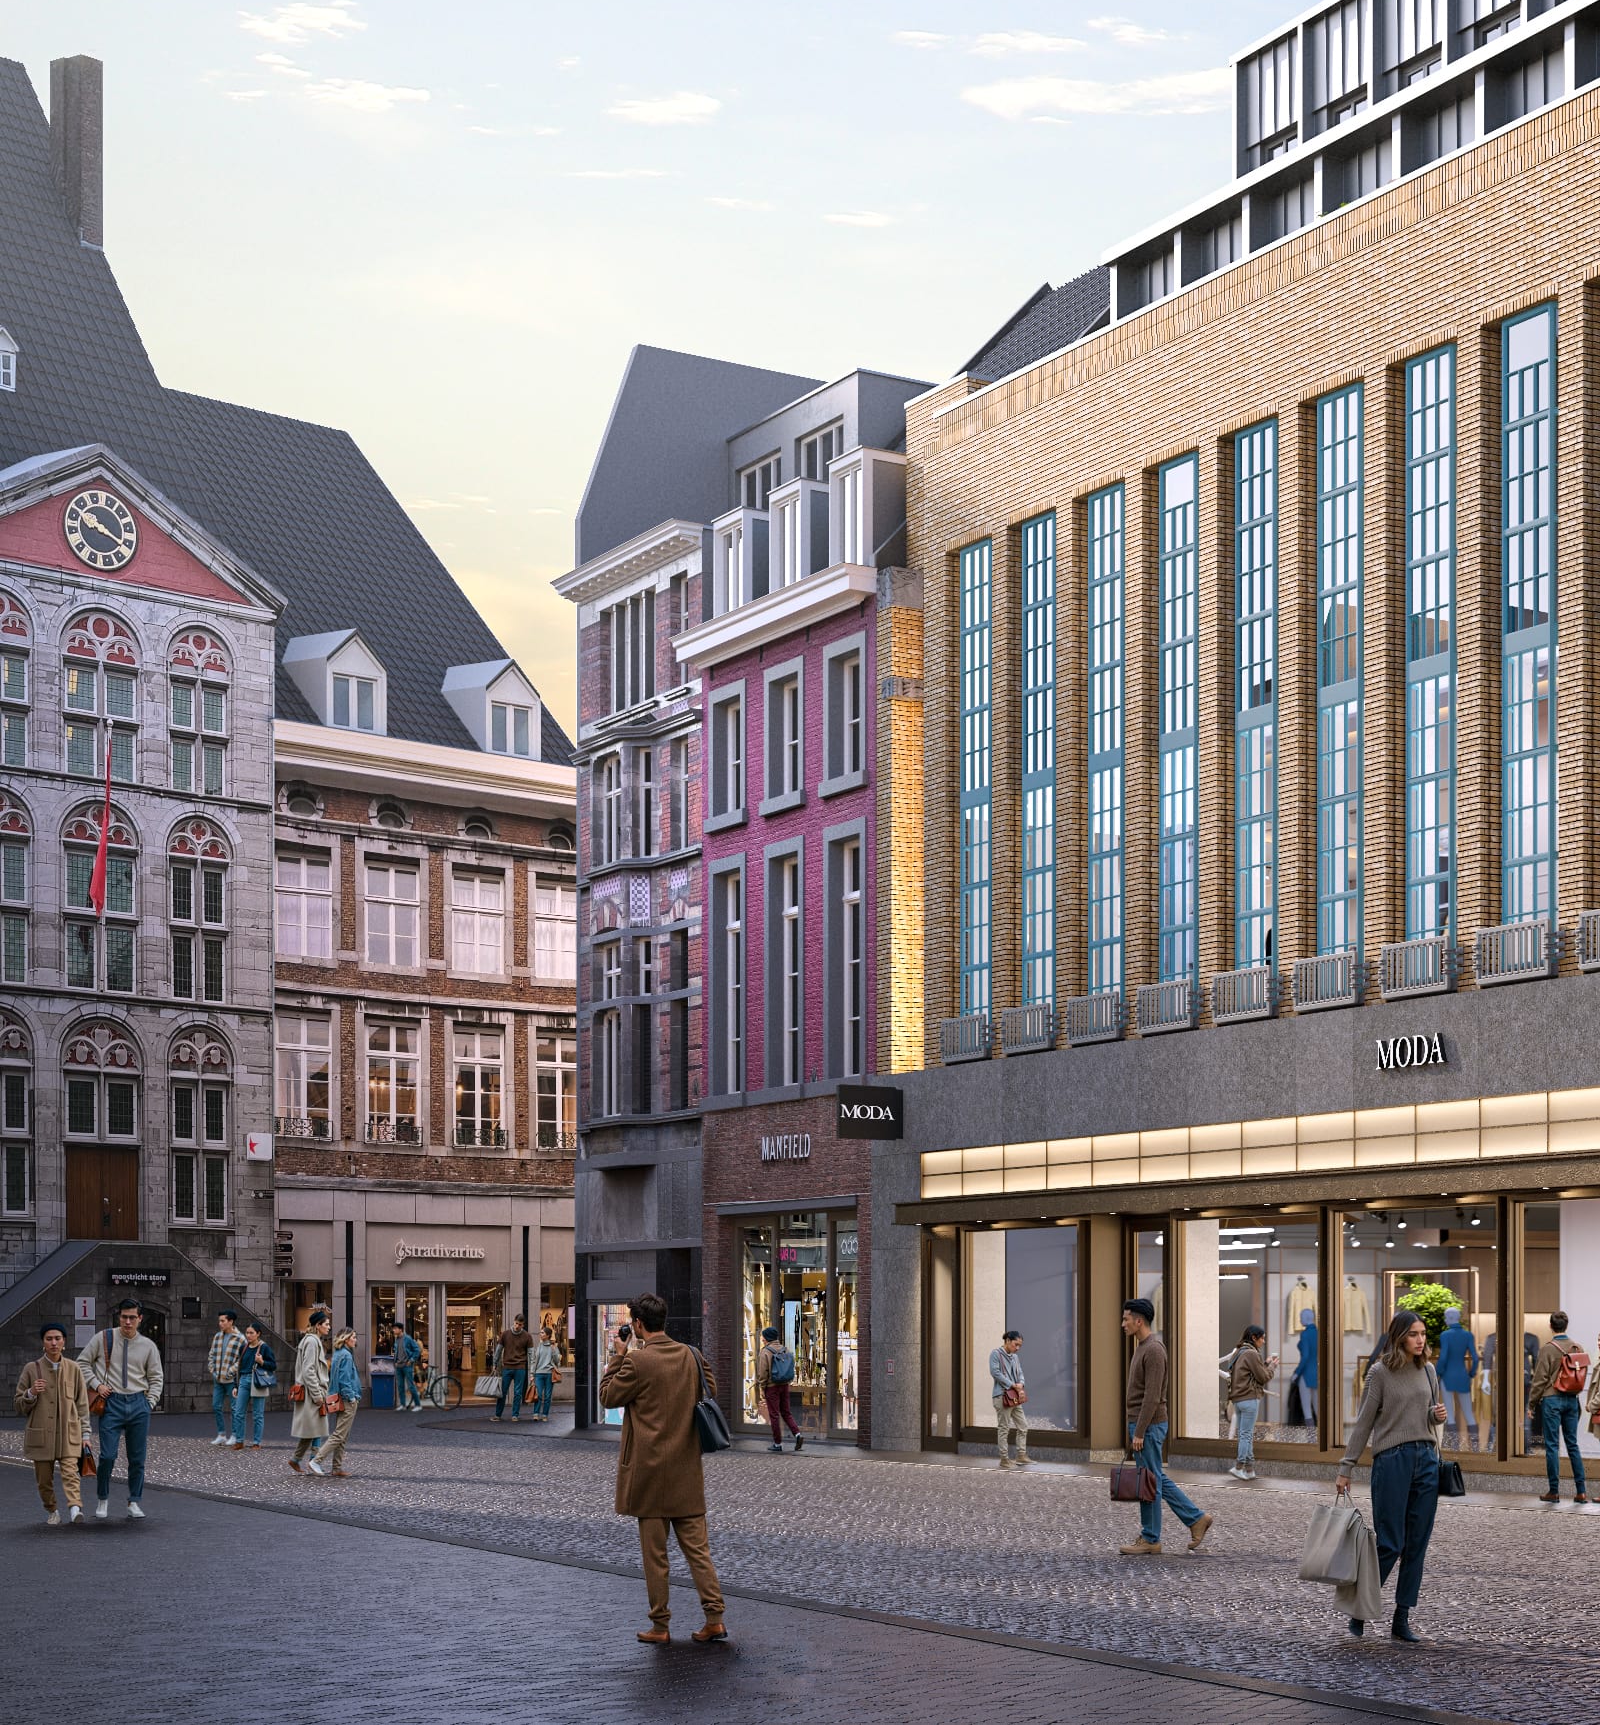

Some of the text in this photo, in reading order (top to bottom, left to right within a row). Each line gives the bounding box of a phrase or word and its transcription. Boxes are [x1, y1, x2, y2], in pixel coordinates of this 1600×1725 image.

[1375, 1032, 1445, 1072] MODA
[840, 1103, 895, 1121] MODA
[761, 1133, 811, 1161] MANFIELD
